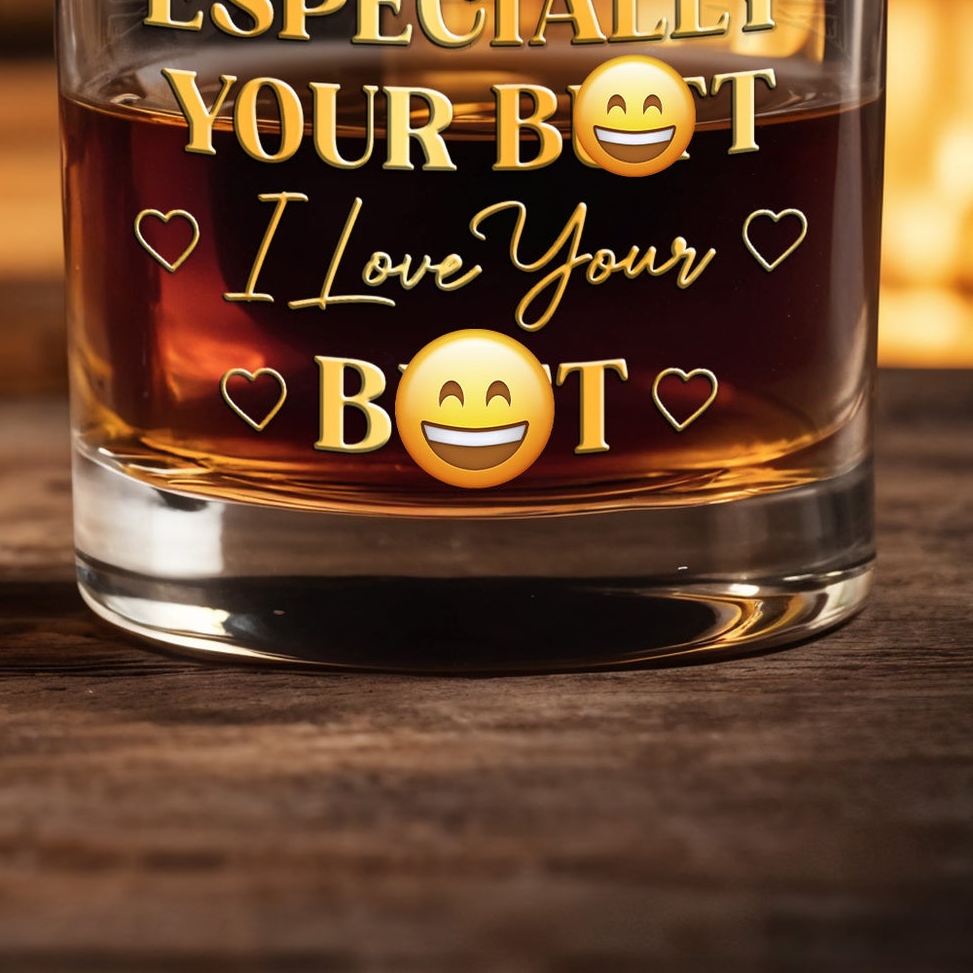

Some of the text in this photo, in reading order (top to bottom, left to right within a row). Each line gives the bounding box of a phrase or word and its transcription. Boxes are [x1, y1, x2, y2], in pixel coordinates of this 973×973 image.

[161, 67, 777, 171] YOUR BT
[223, 191, 717, 331] I Love Your
[313, 354, 629, 454] BT
